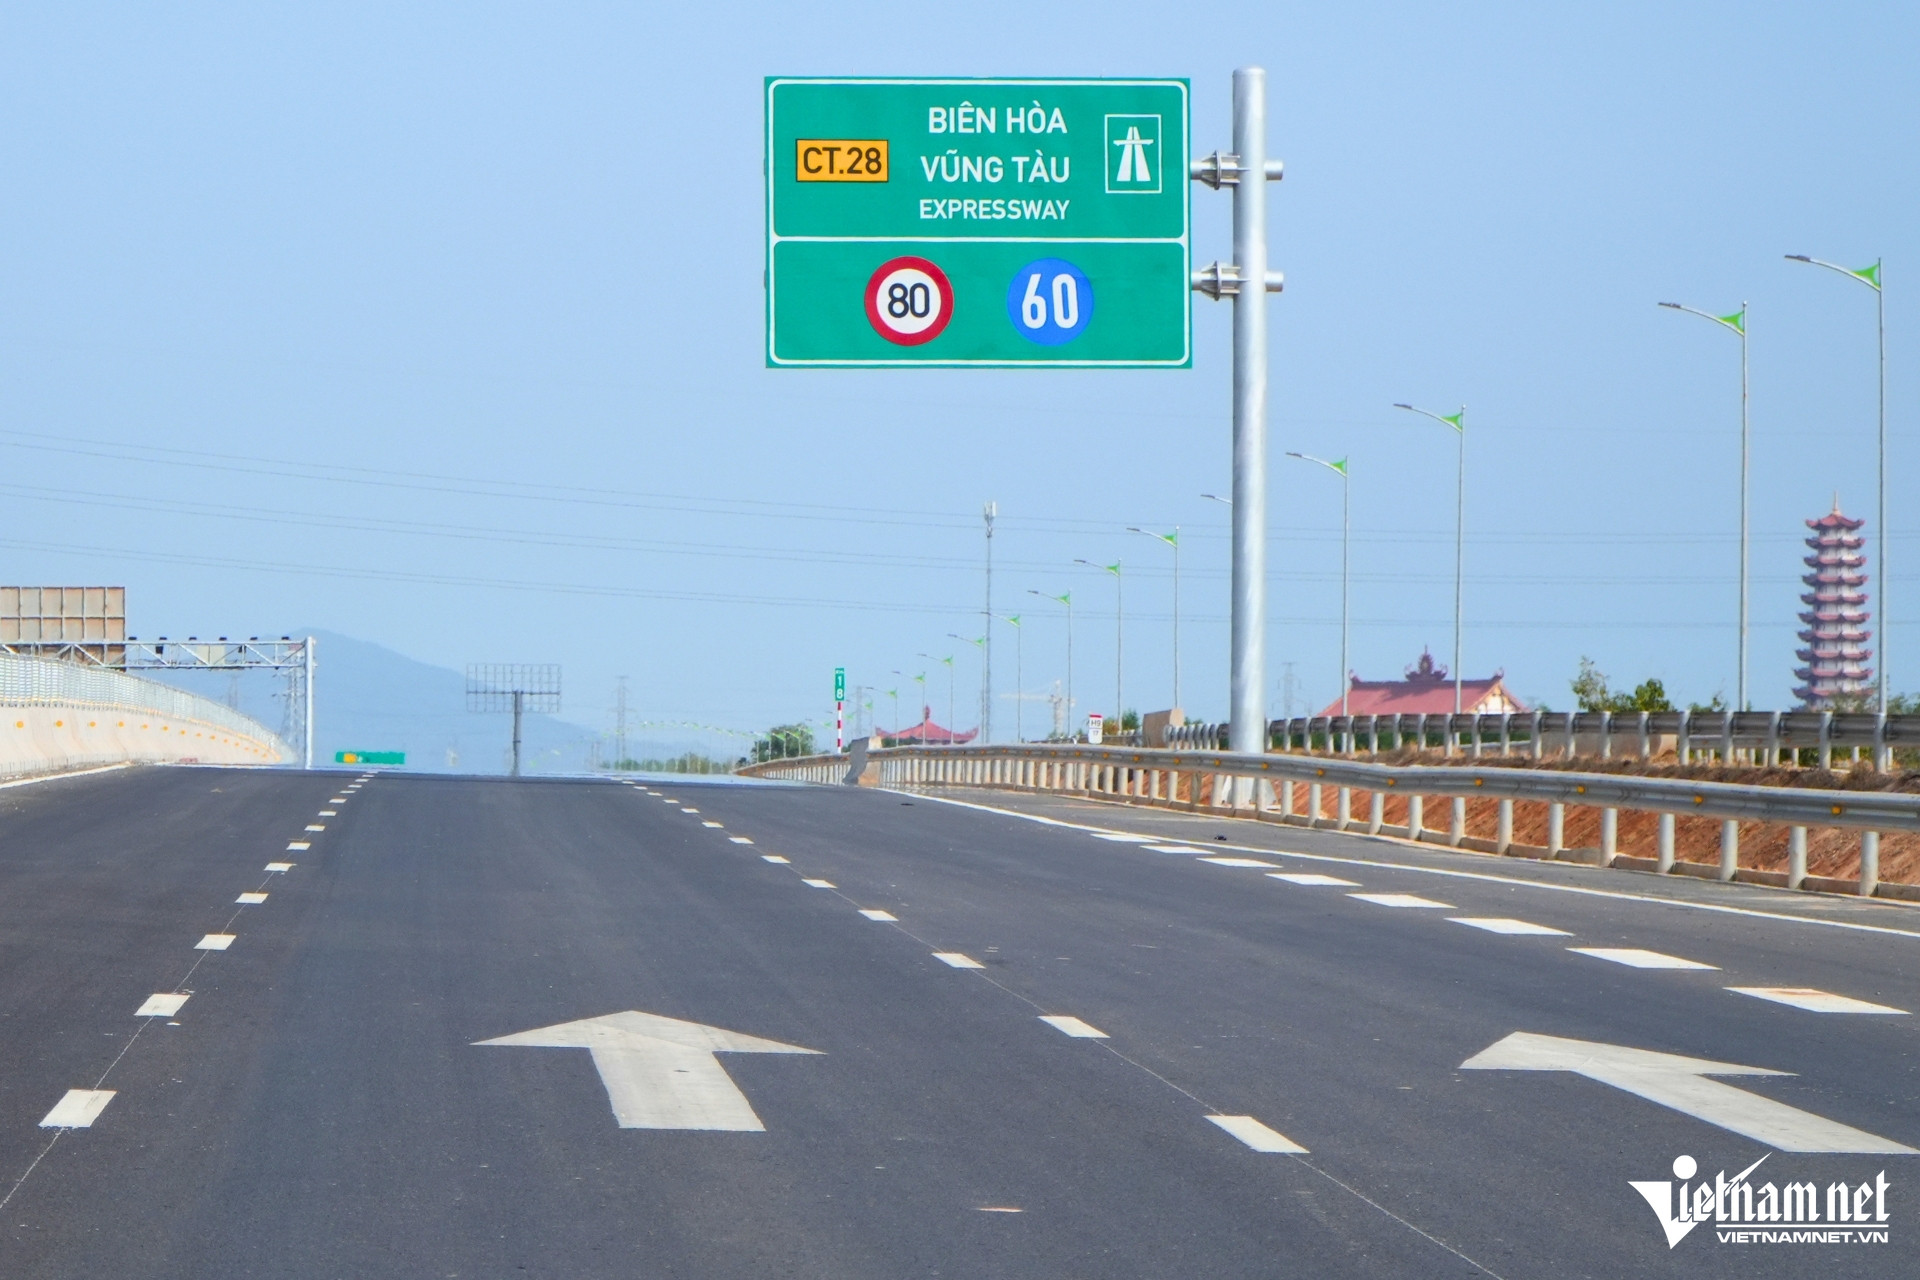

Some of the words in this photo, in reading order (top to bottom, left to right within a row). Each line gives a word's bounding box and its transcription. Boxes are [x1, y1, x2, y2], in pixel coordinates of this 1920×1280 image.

[929, 101, 995, 134] BIÊN
[1007, 101, 1067, 134] HÒA
[803, 146, 882, 175] CT.28
[921, 150, 1003, 183] VŨNG
[1012, 150, 1070, 183] TÀU
[919, 199, 1070, 220] EXPRESSWAY
[887, 282, 930, 318] 80
[1021, 273, 1079, 329] 60
